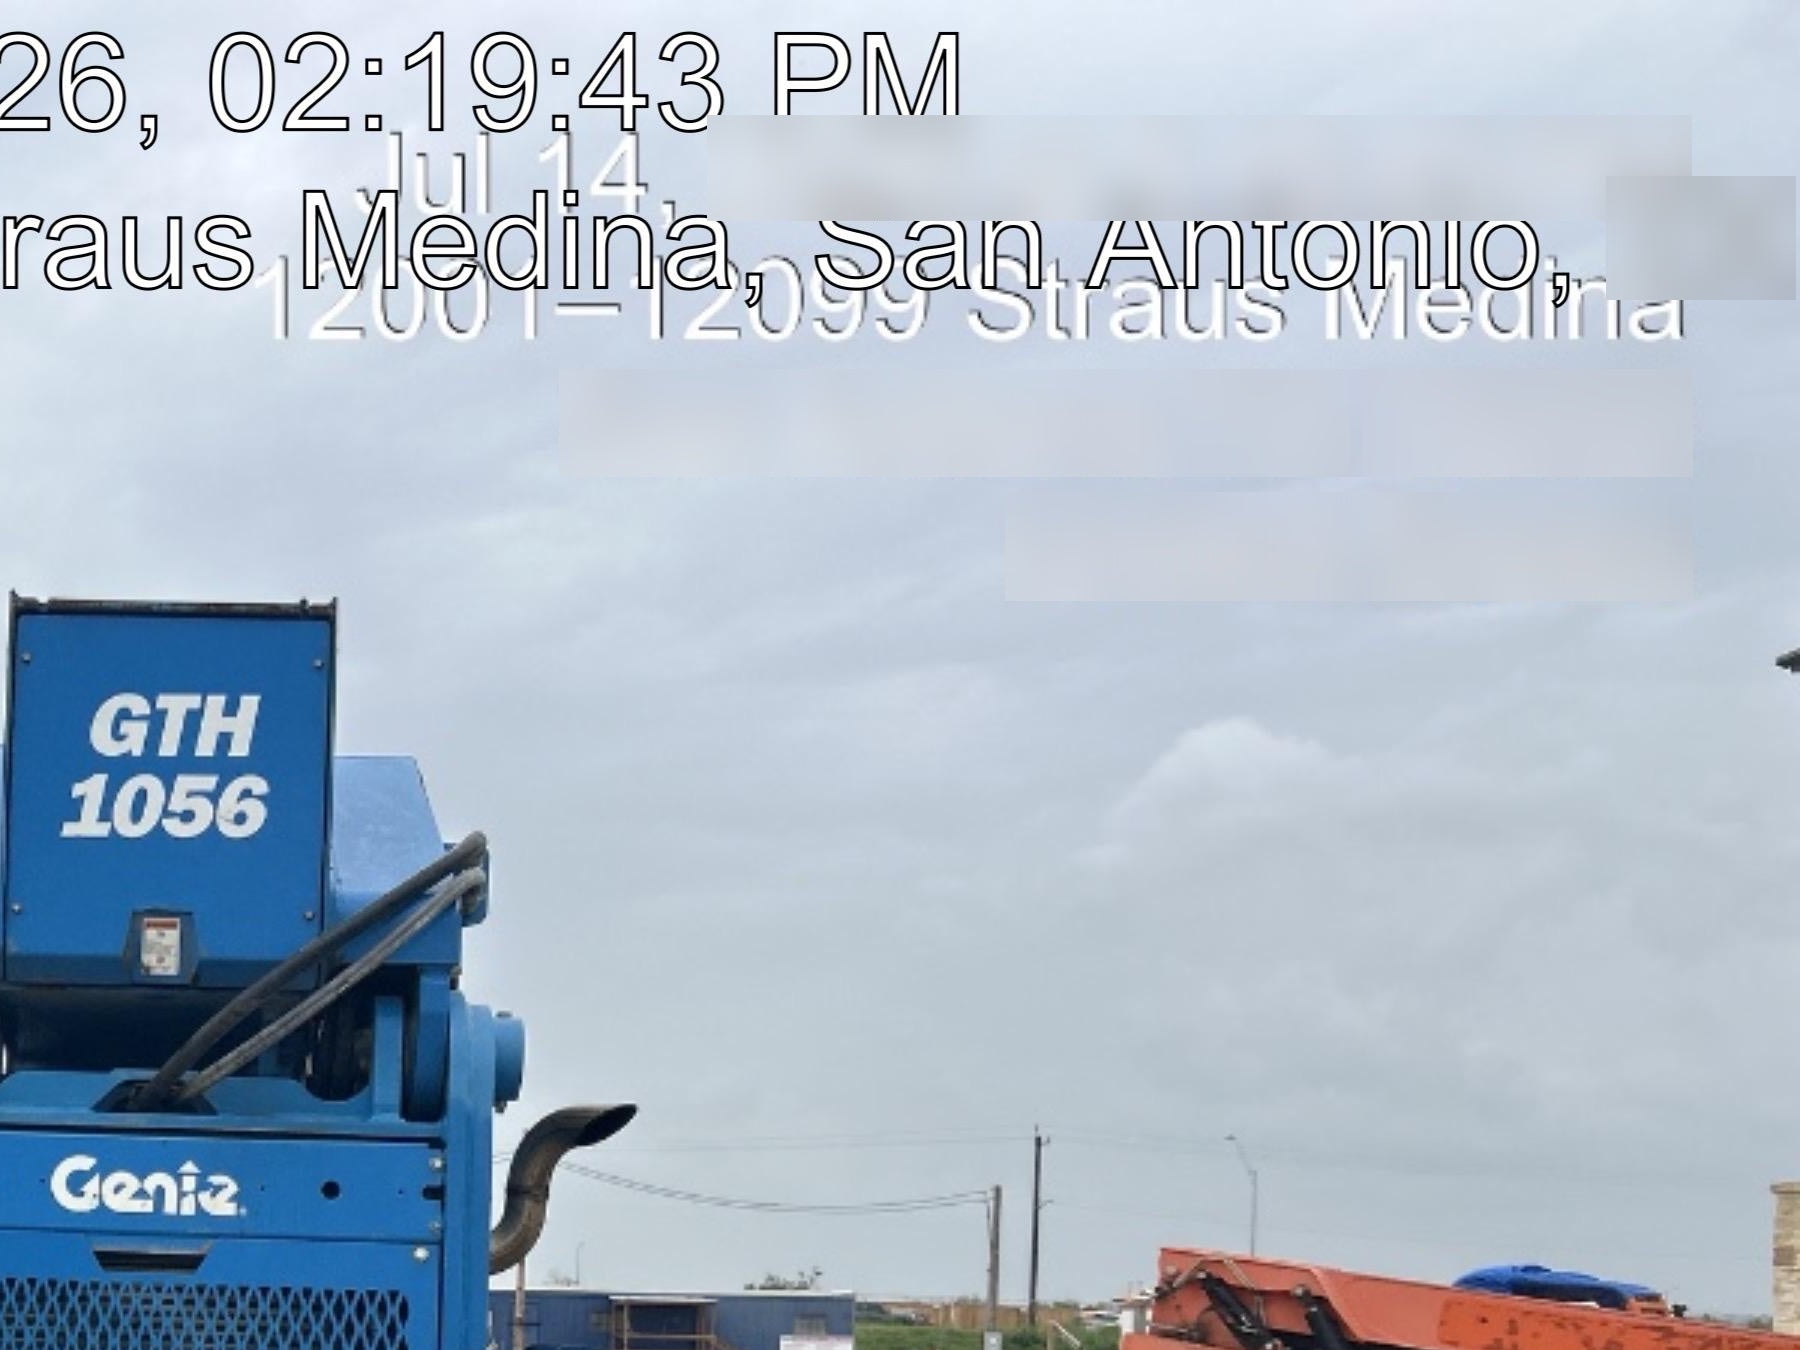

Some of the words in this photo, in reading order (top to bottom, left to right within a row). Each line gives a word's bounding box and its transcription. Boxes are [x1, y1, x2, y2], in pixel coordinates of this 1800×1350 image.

[89, 692, 262, 757] GTH
[60, 774, 270, 838] 1056
[50, 1154, 240, 1217] Genie
